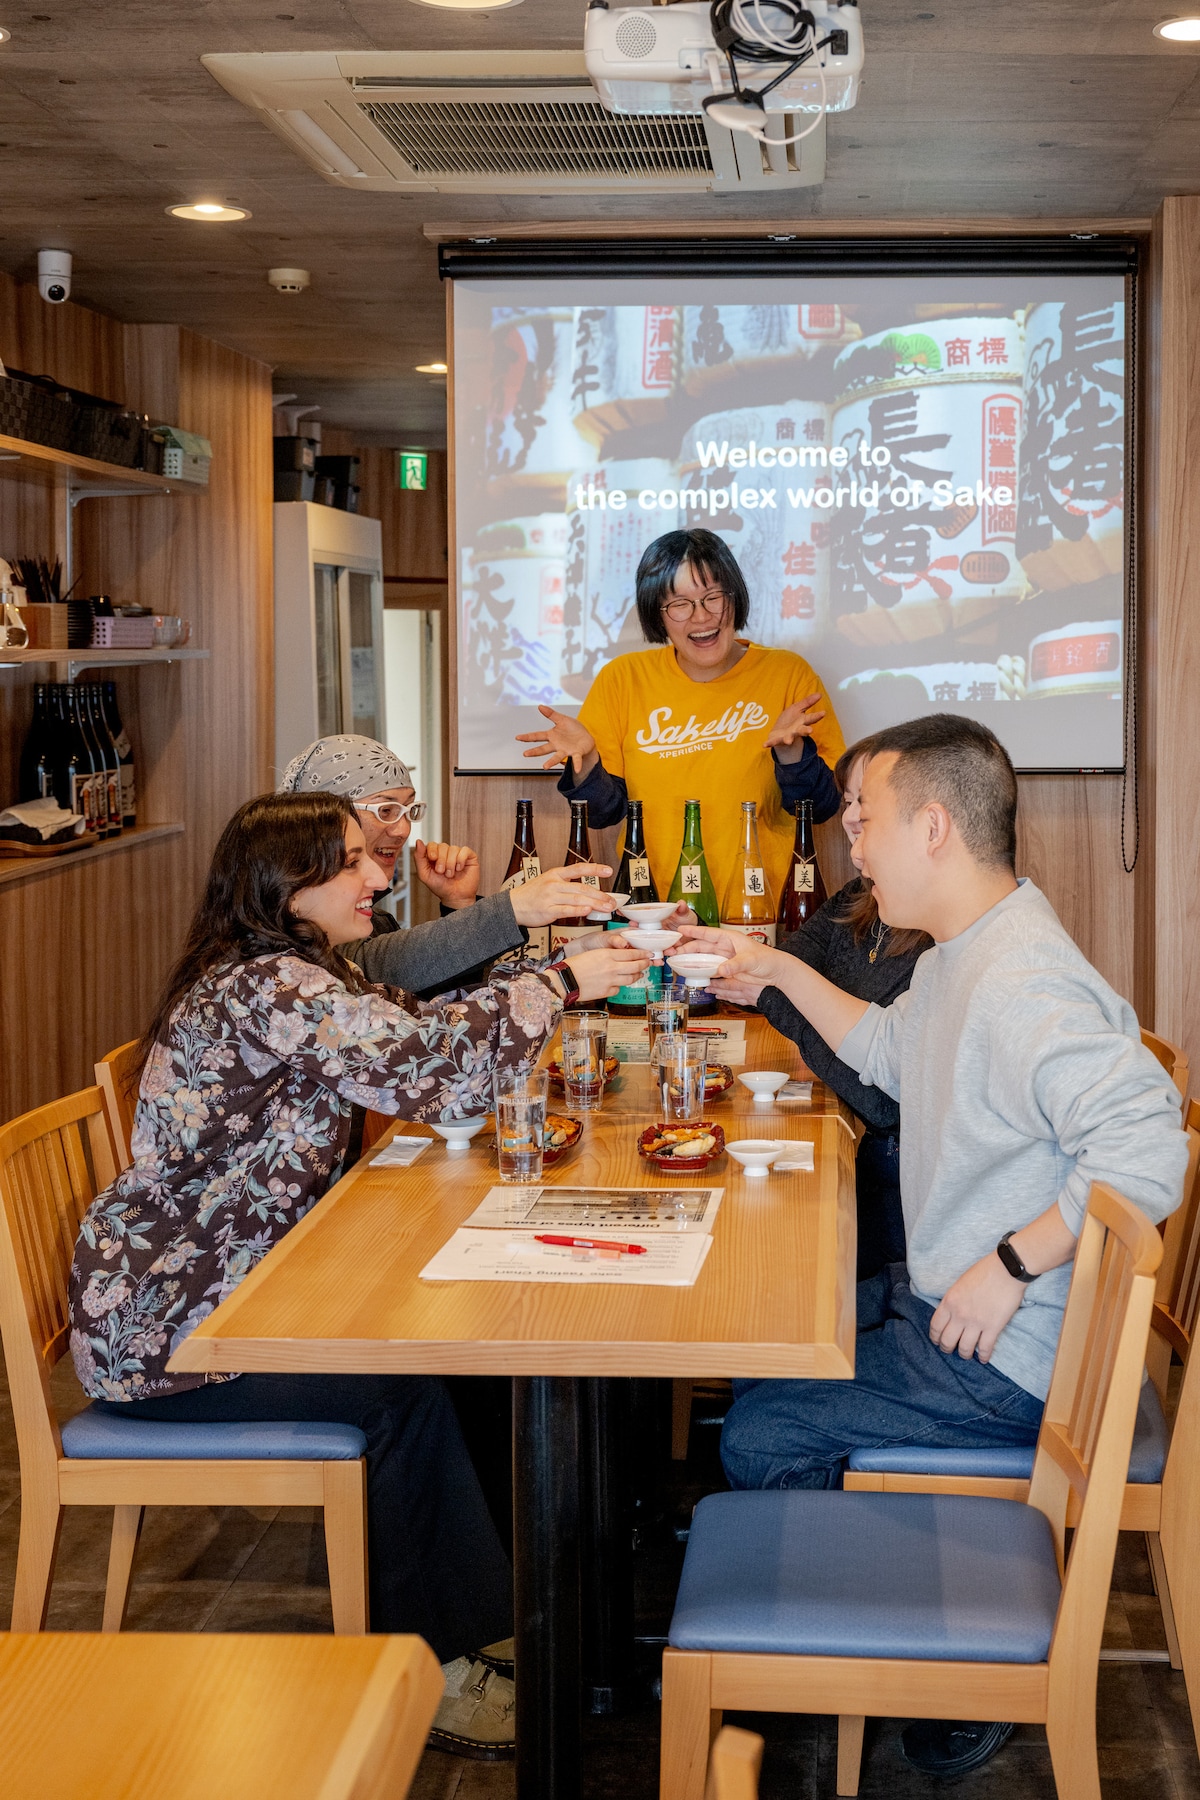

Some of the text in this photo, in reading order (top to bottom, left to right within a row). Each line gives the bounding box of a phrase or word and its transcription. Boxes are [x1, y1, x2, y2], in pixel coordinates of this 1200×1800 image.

[944, 336, 1009, 368] 商標
[696, 440, 892, 468] Welcome to
[574, 482, 628, 511] the
[638, 481, 777, 516] complex
[787, 480, 880, 510] world
[890, 479, 921, 508] of
[932, 478, 1013, 508] Sake
[636, 700, 769, 745] Sakelife
[659, 741, 713, 759] XPERIENCE
[634, 866, 648, 882] 飛
[685, 873, 700, 889] 米
[748, 874, 763, 893] 亀
[798, 870, 813, 889] 美
